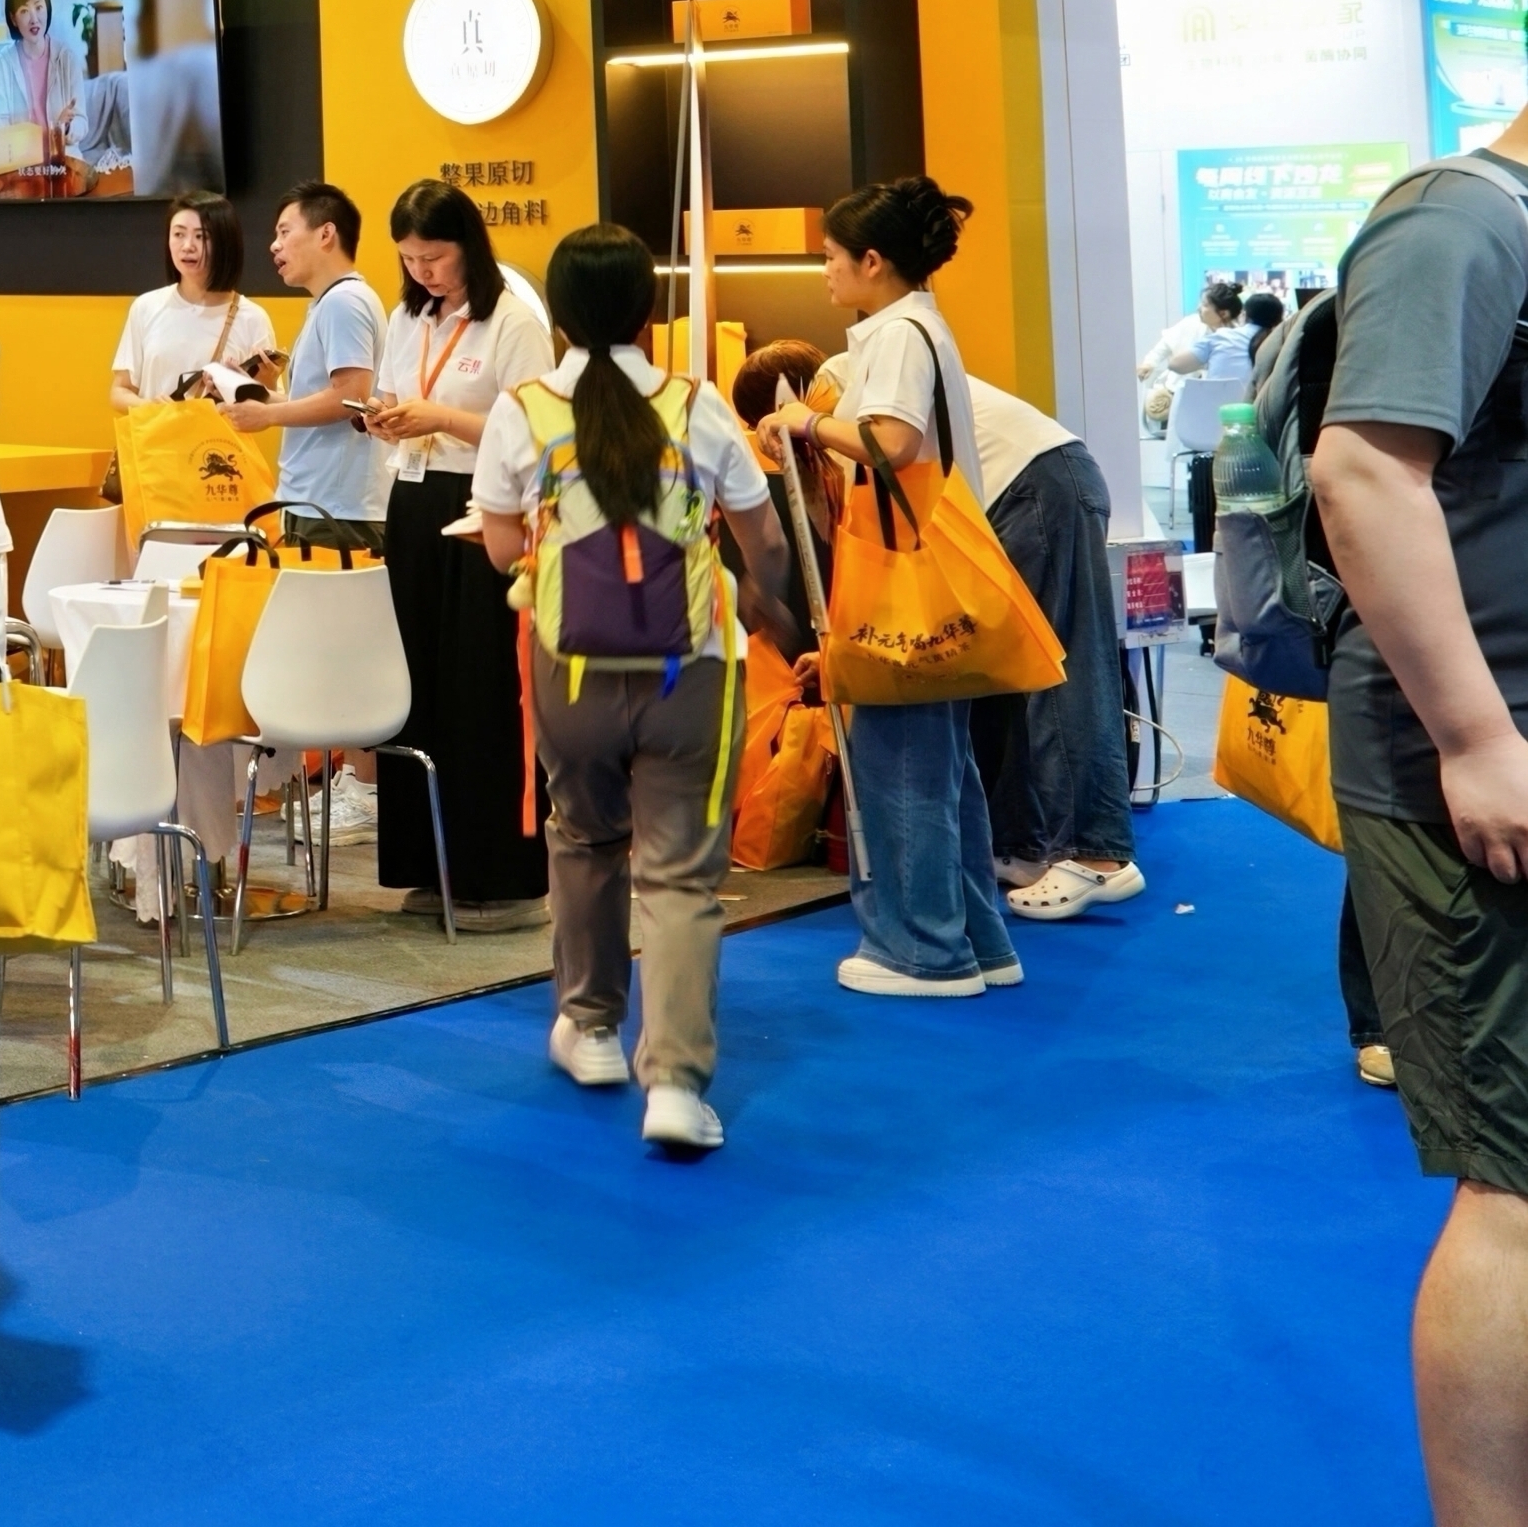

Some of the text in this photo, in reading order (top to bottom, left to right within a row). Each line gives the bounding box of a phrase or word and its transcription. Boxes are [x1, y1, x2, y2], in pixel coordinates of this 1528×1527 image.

[440, 160, 535, 189] 整果原切
[849, 614, 978, 654] 补元气喝九华尊
[1247, 726, 1276, 757] 九华尊
